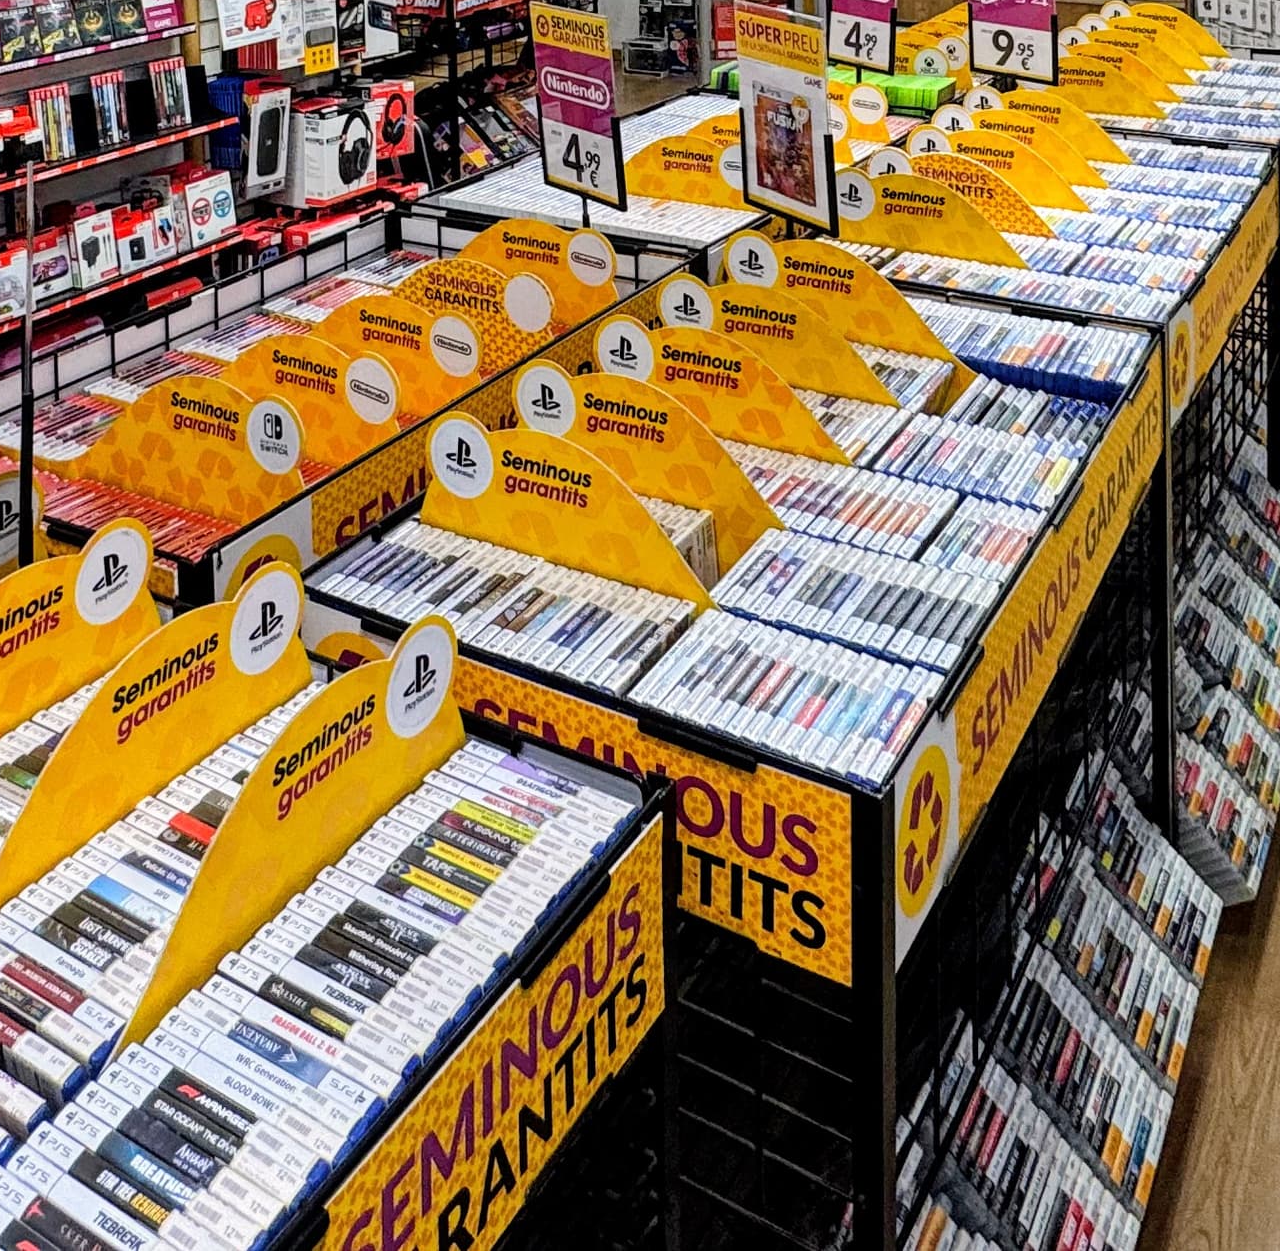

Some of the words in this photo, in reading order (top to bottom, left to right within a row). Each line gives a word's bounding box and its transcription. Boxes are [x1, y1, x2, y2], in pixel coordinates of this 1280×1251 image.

[552, 16, 605, 38] SEMINOUS
[739, 18, 783, 46] SÚPER
[784, 31, 819, 54] PREU
[552, 32, 605, 52] GARANTITS
[547, 74, 604, 102] Nintendo
[804, 77, 822, 89] GAME
[660, 147, 715, 163] Seminous
[661, 158, 714, 174] garantits
[881, 185, 946, 210] Seminous
[882, 199, 944, 220] garantits
[426, 273, 498, 299] SEMINOUS
[424, 288, 501, 314] GARANTITS
[359, 308, 423, 337] Seminous
[361, 325, 421, 351] garantits
[272, 349, 339, 381] Seminous
[661, 345, 742, 376] Seminous
[274, 365, 336, 396] garantits
[664, 361, 739, 391] garantits
[501, 449, 592, 489] Seminous
[504, 471, 588, 509] garantits
[972, 546, 1085, 776] SEMINOUS
[1083, 397, 1163, 561] GARANTITS
[272, 692, 376, 788] Seminous
[276, 721, 373, 821] garantits
[444, 830, 507, 861] AFTERIMAGE
[422, 856, 455, 877] TAPE
[322, 985, 368, 1014] TIEBREAK
[272, 1015, 299, 1036] DRAGON
[301, 1030, 318, 1046] BALL
[236, 1053, 253, 1069] WRC
[224, 1076, 252, 1097] BLOOD
[415, 953, 649, 1251] RANTITS
[153, 1099, 174, 1116] STAR
[203, 1129, 218, 1144] THE
[96, 1170, 117, 1191] STAR
[115, 1181, 137, 1201] TREK
[93, 1211, 146, 1250] TIEBREAK
